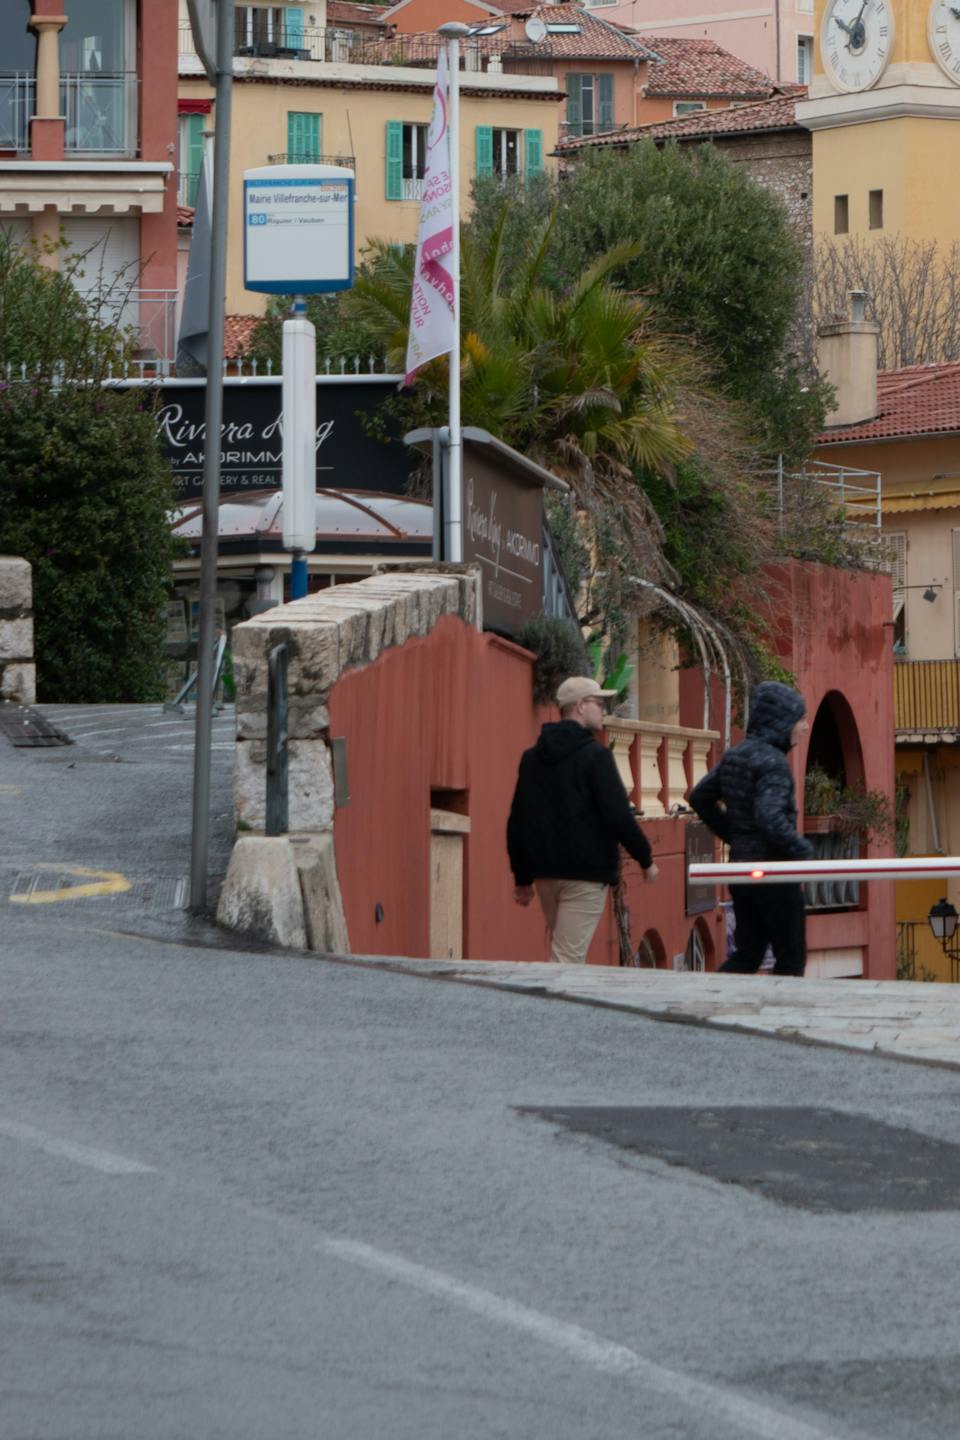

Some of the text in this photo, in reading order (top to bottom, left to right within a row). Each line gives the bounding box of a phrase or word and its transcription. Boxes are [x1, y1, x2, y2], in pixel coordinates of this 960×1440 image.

[249, 191, 348, 204] Mairie Villefranche-sur-Mer
[251, 215, 265, 225] 80
[252, 476, 277, 486] REAL
